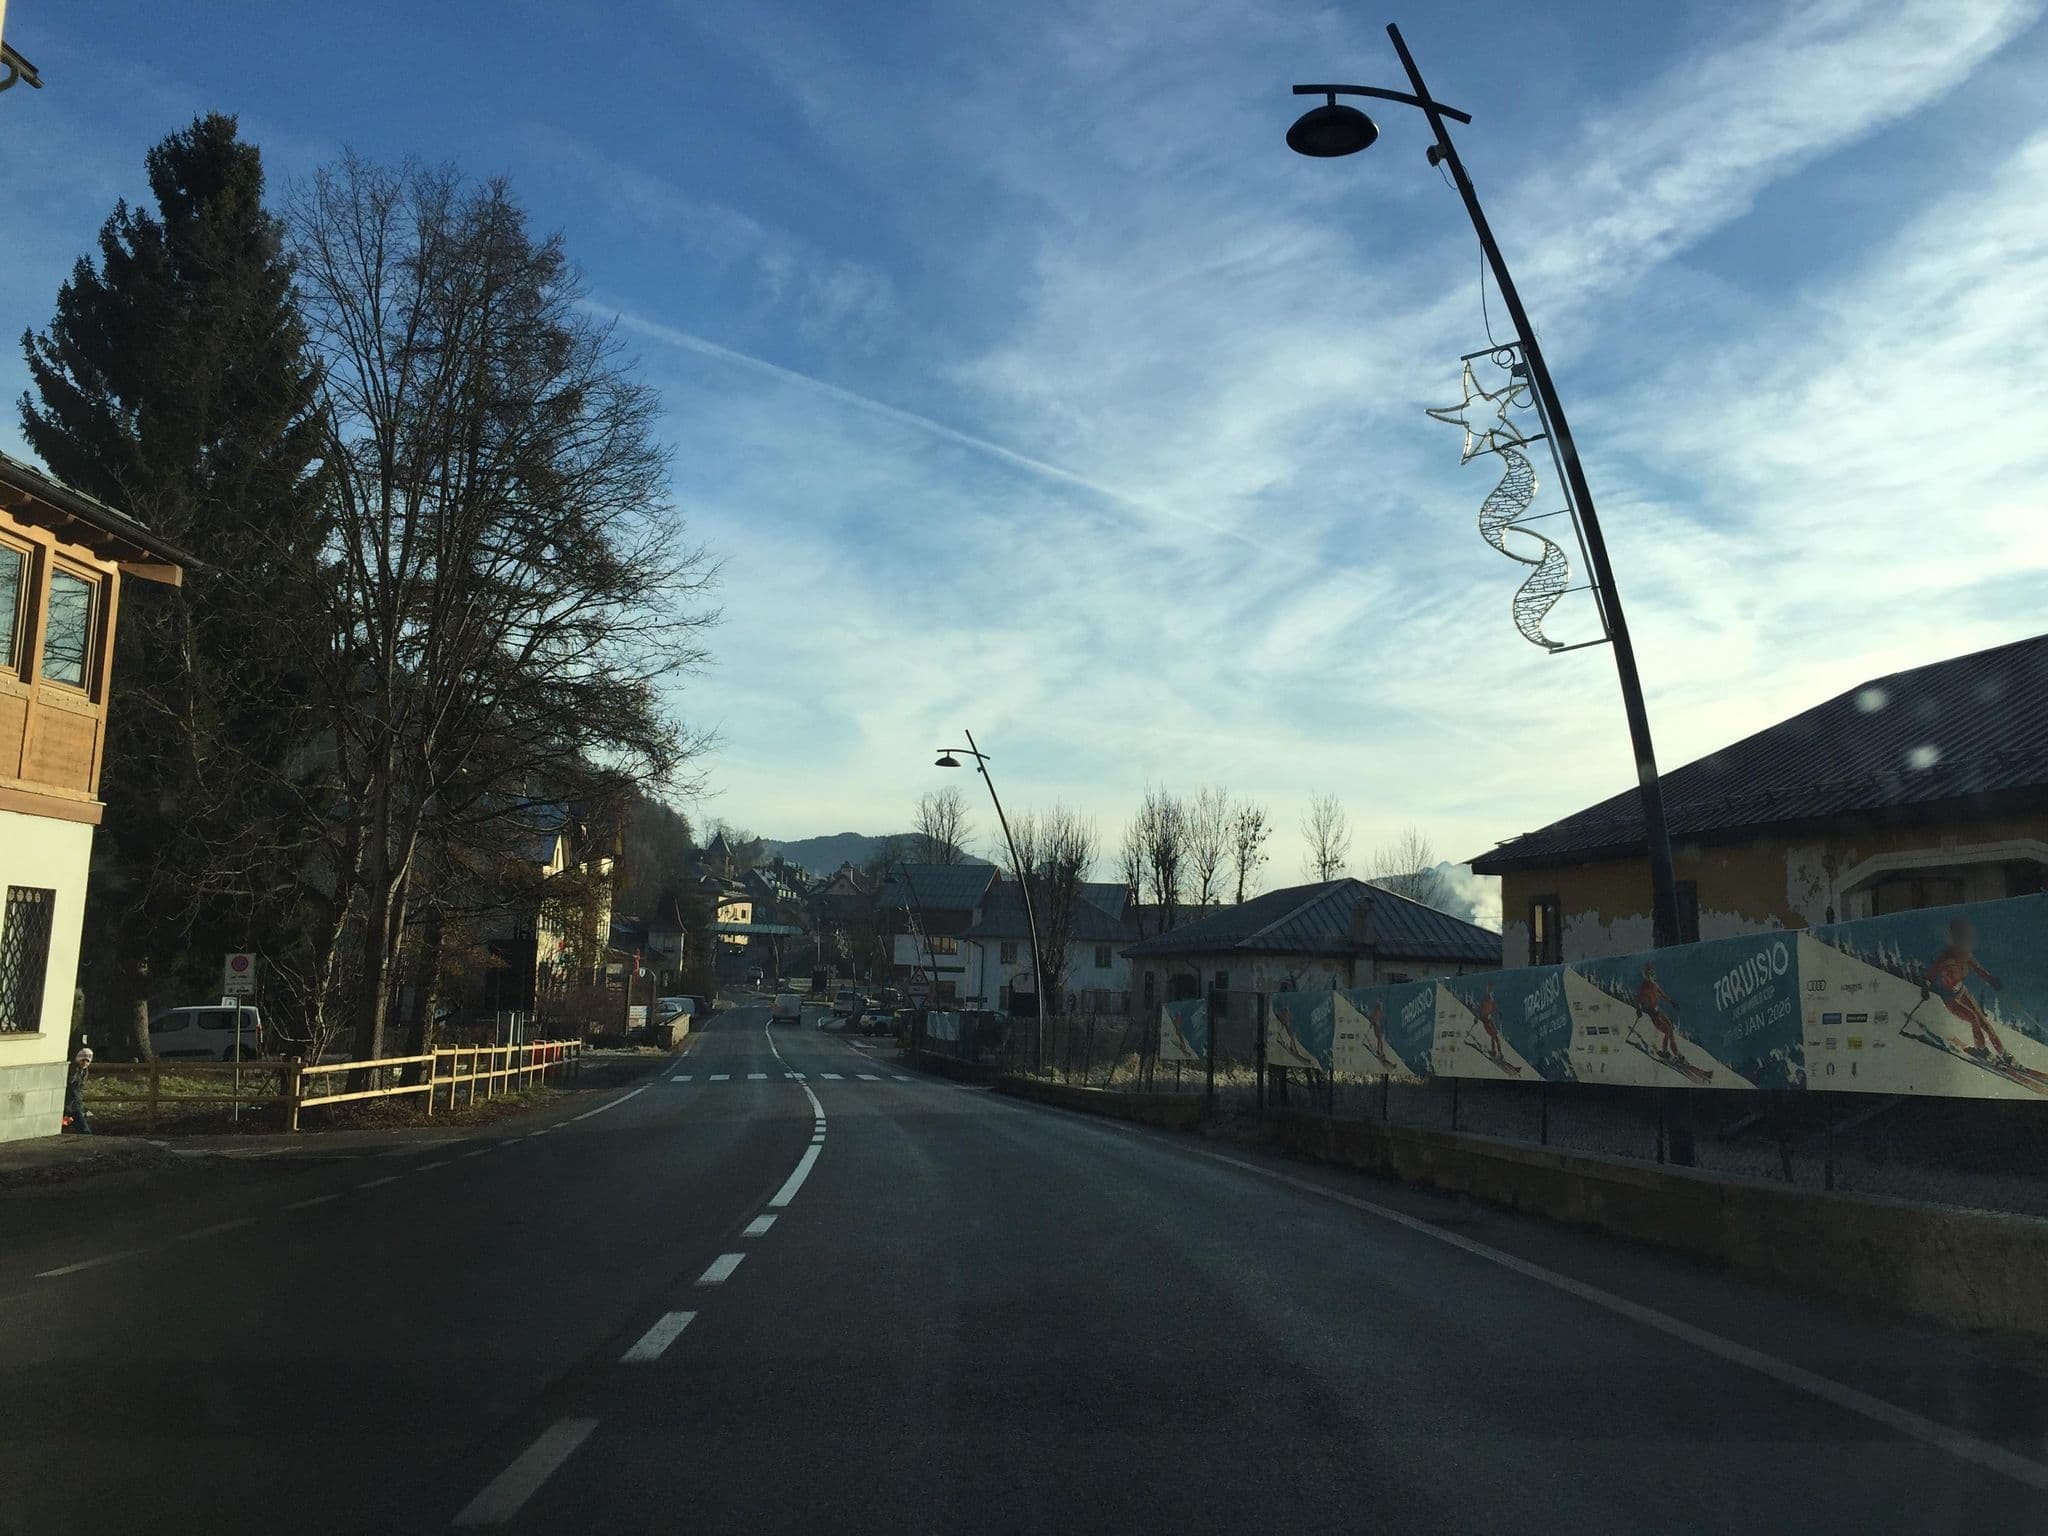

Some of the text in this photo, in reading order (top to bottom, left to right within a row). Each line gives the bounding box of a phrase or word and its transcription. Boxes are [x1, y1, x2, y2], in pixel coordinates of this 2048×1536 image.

[1713, 940, 1789, 1012] TARVISIO
[1745, 1012, 1766, 1036] JAN
[1767, 996, 1792, 1025] 2026
